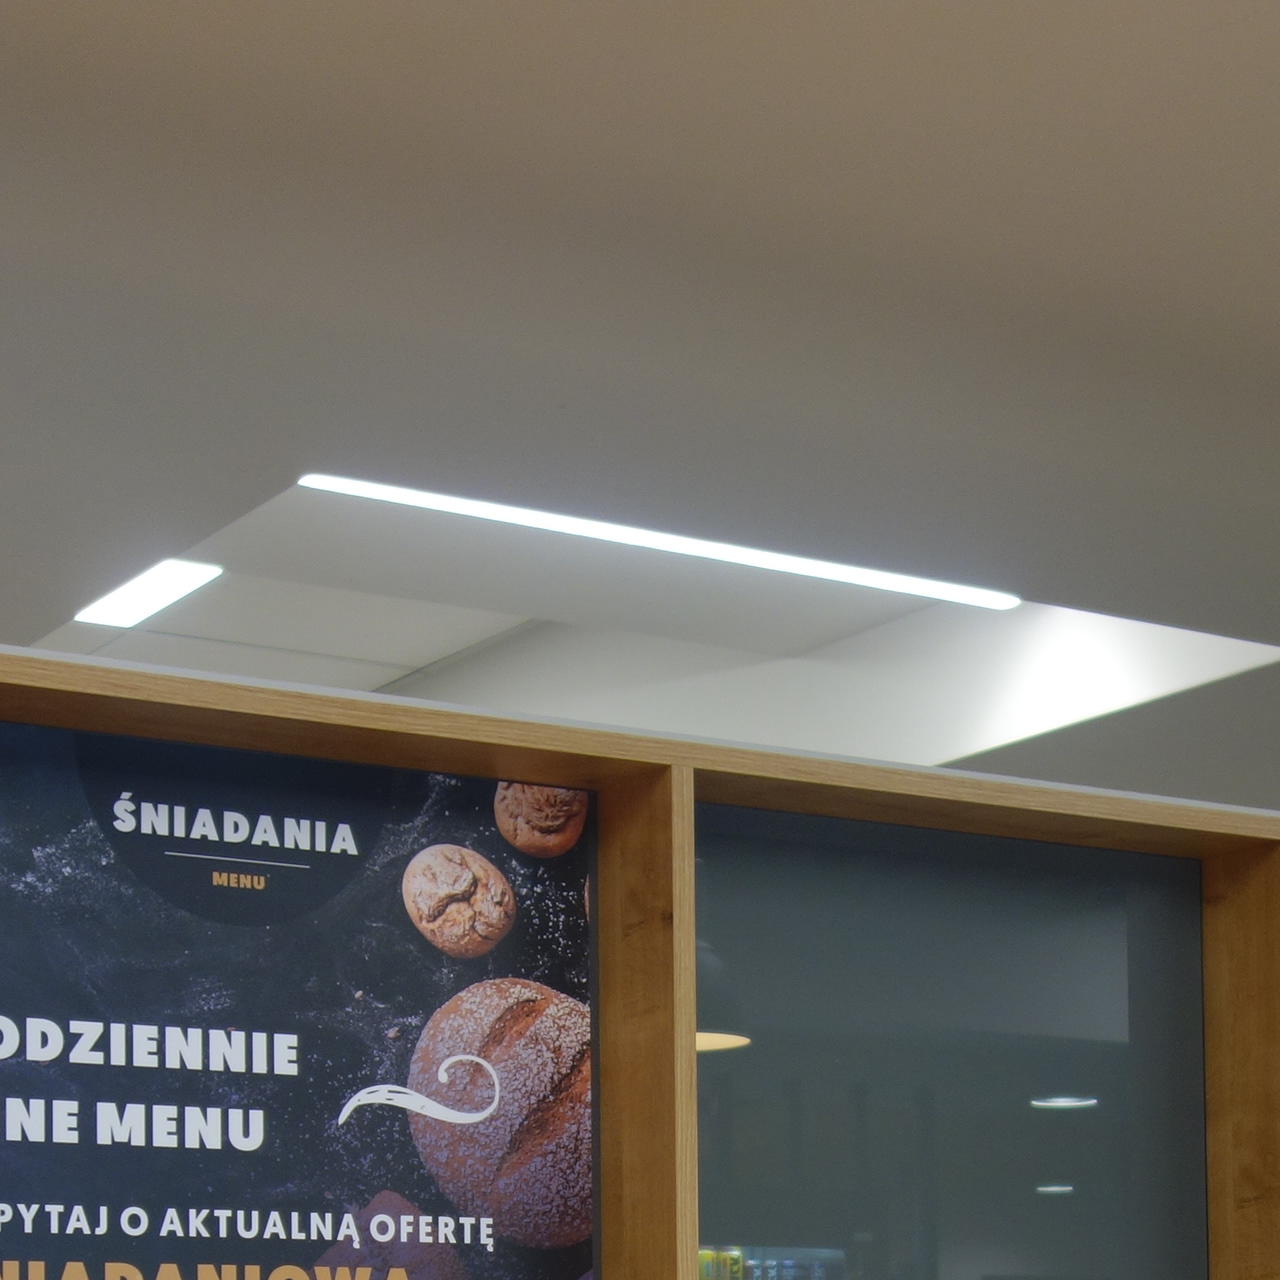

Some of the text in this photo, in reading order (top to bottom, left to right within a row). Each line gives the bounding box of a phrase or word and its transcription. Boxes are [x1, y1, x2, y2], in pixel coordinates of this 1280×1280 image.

[113, 792, 358, 855] ŚNIADANIA
[212, 871, 266, 890] MENU
[96, 1102, 264, 1151] MENU
[120, 1206, 149, 1236] O
[160, 1208, 362, 1249] AKTUALNĄ
[370, 1213, 494, 1252] OFERTĘ
